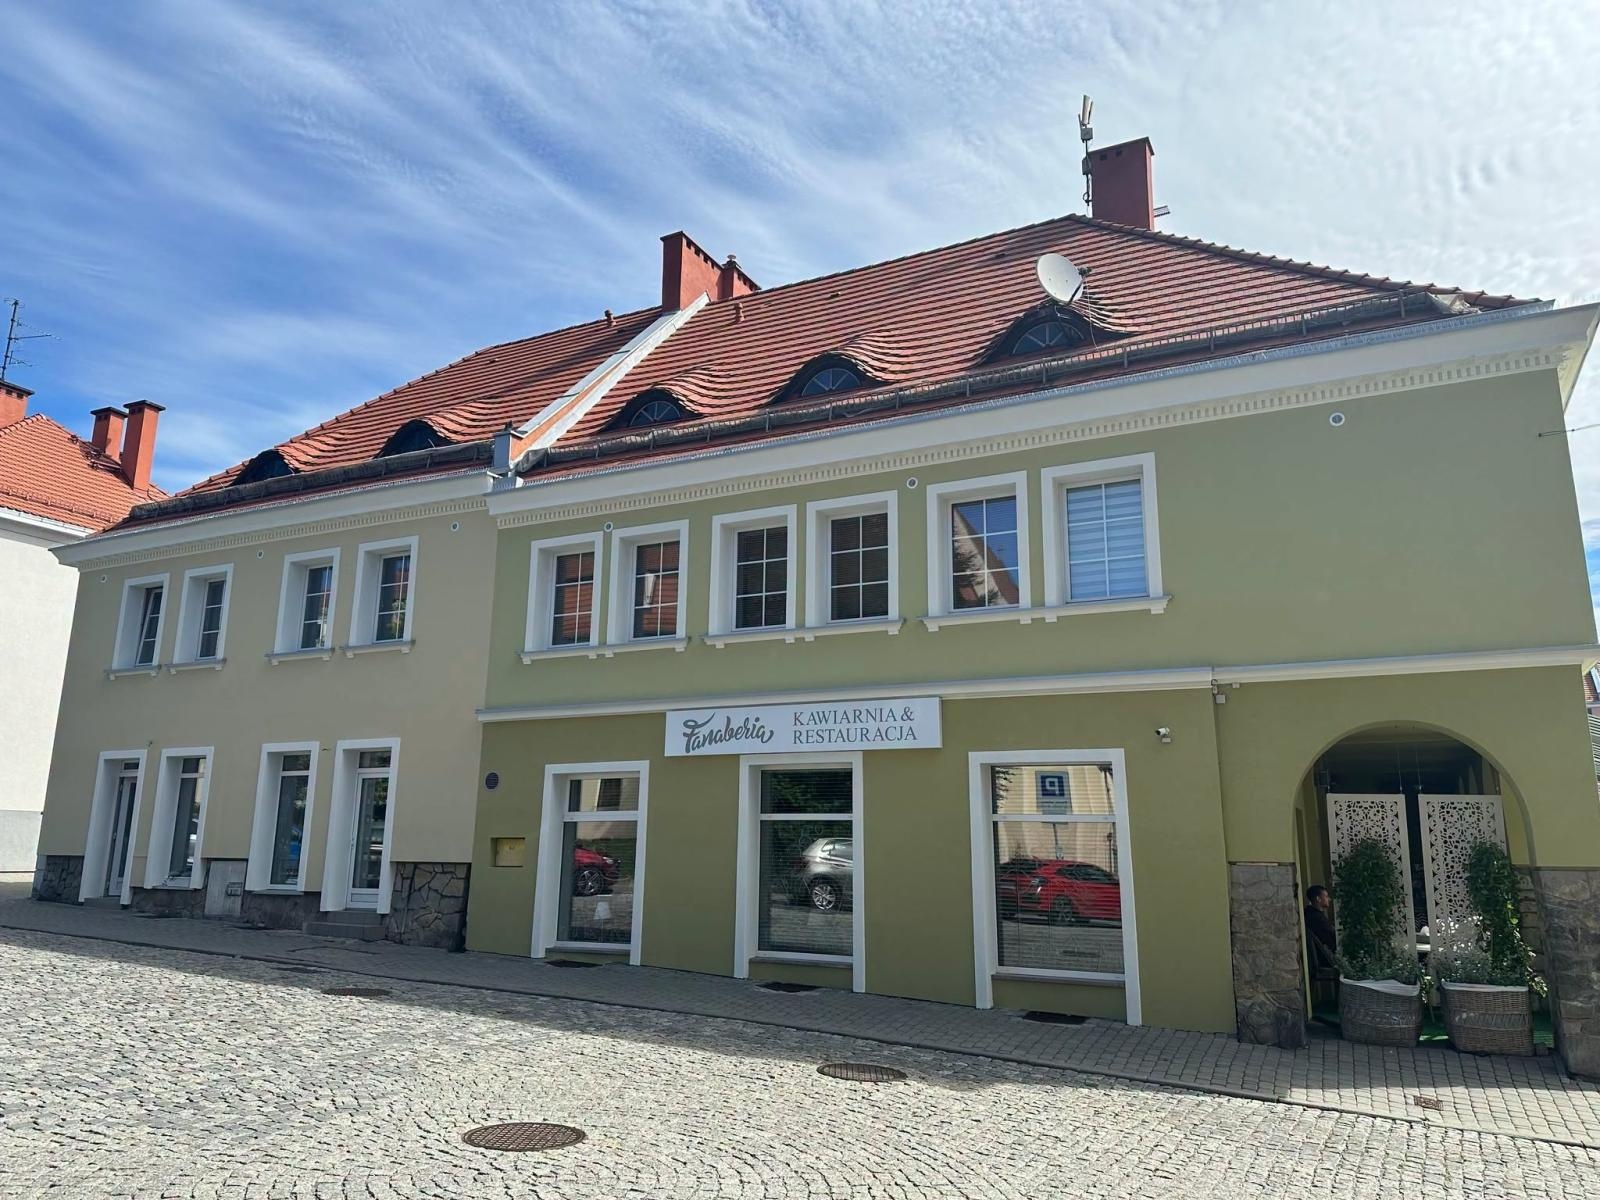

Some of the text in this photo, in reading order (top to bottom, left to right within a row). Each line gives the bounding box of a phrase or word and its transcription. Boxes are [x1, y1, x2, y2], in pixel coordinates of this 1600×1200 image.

[793, 707, 898, 727] KAWIARNIA
[683, 712, 774, 753] Fanaberia
[793, 725, 918, 745] RESTAURACJA
